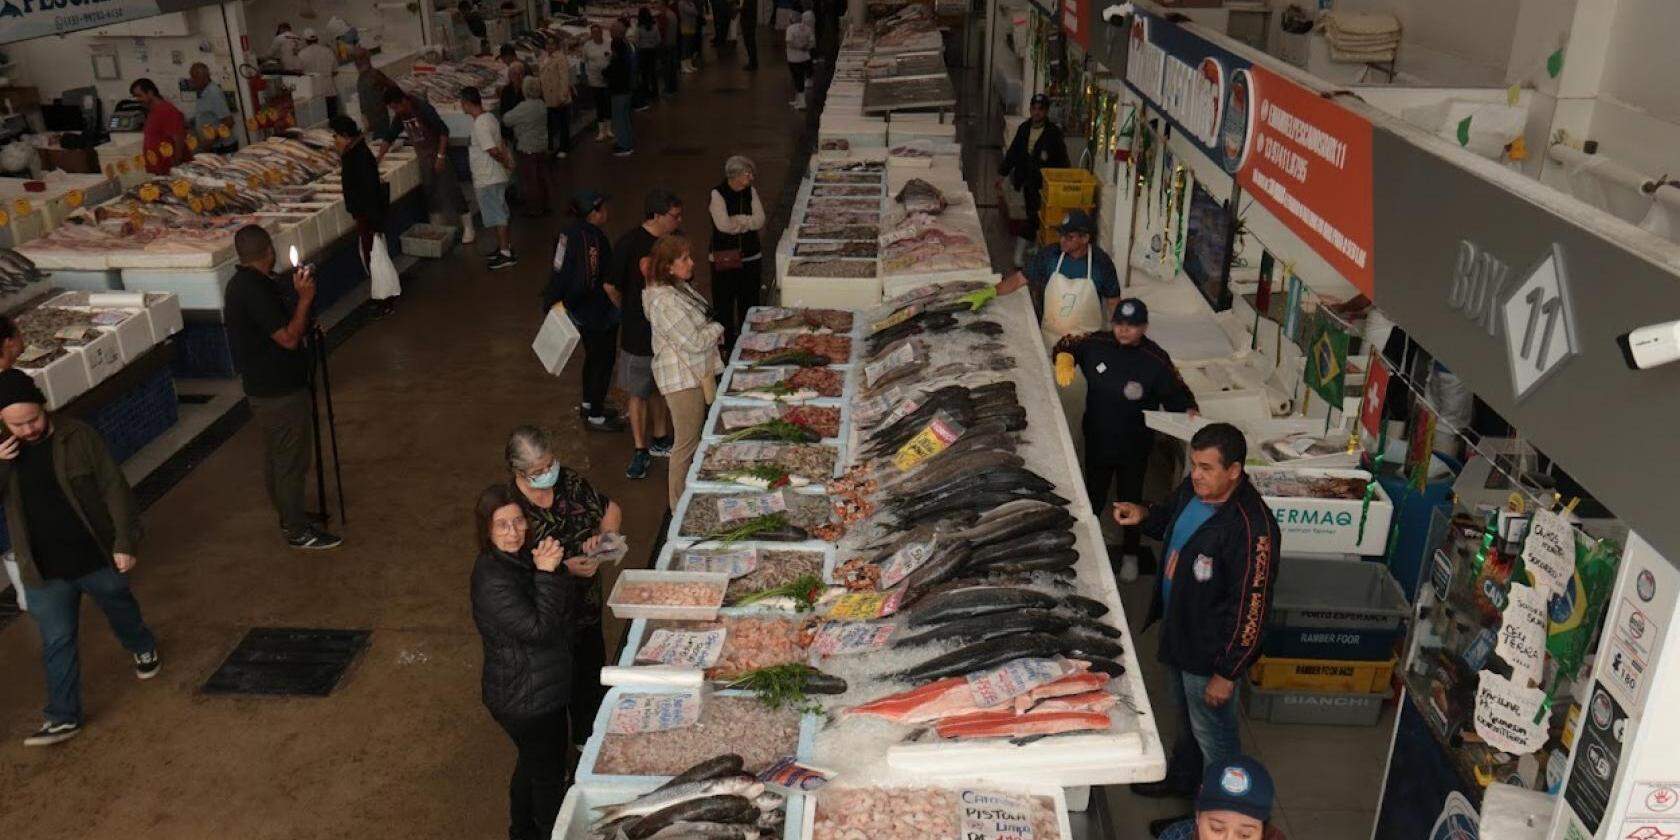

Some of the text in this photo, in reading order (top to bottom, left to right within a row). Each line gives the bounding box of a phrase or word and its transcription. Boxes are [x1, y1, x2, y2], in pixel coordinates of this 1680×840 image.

[1452, 239, 1564, 372] BOX 11
[1273, 508, 1352, 526] ERMAQ
[1284, 695, 1370, 706] BIANCHI
